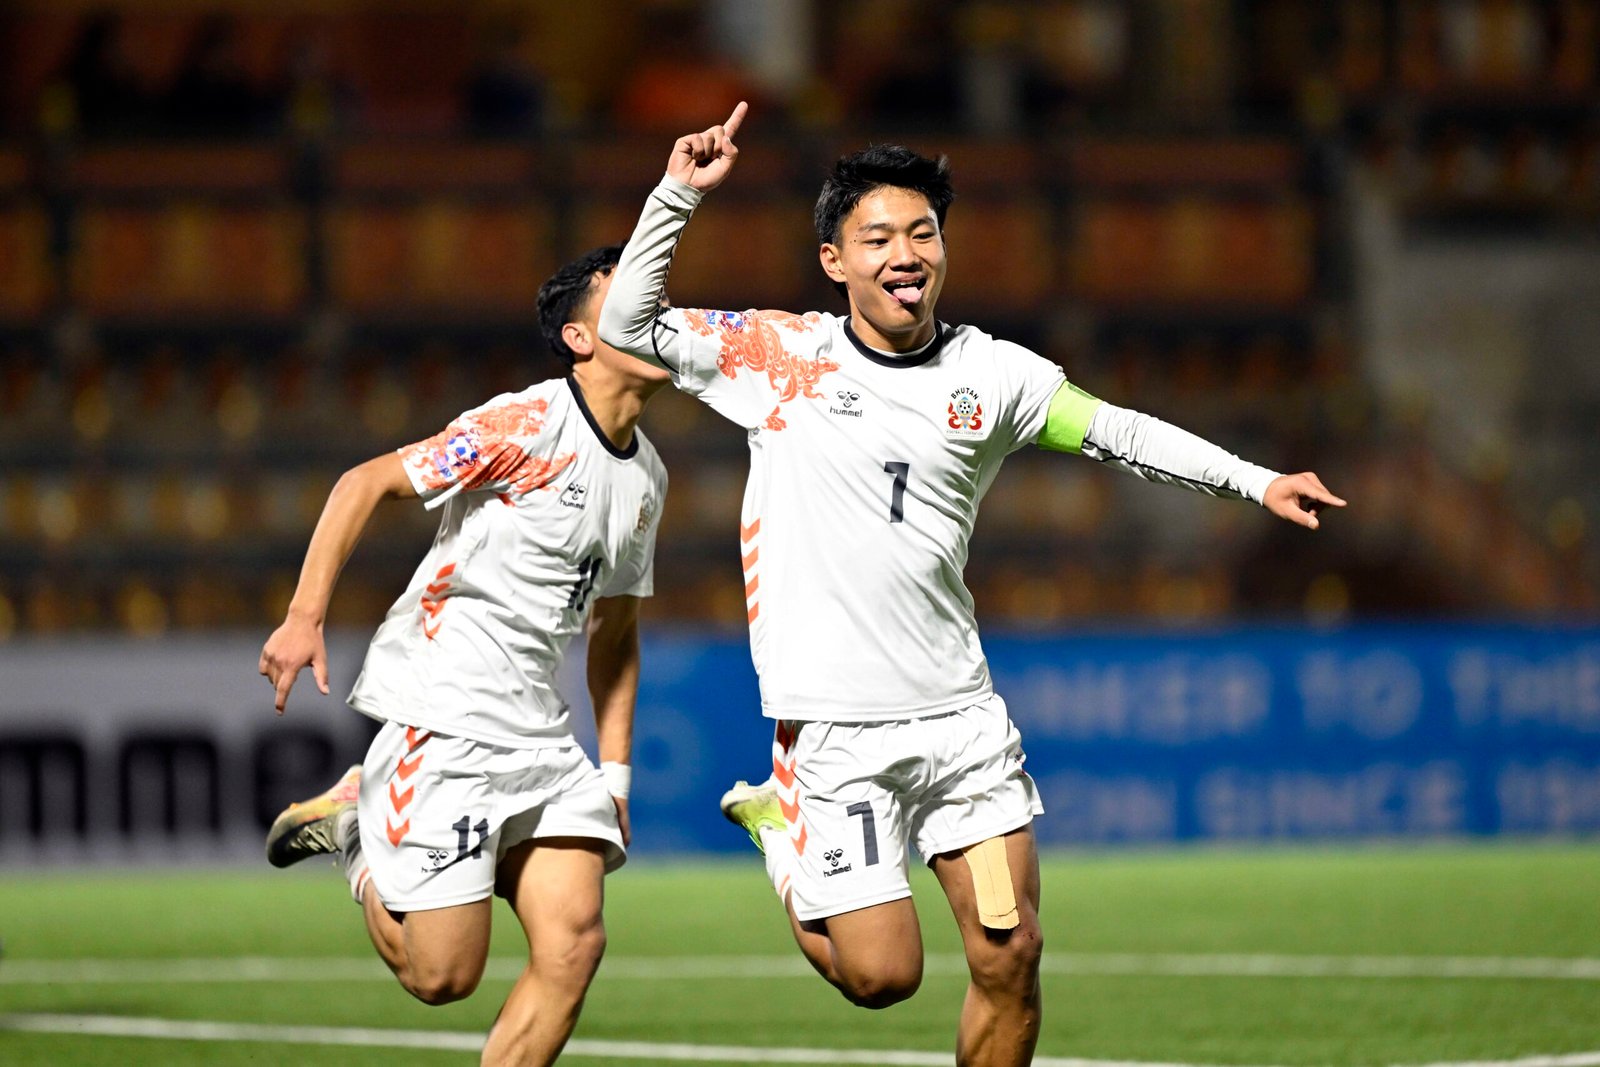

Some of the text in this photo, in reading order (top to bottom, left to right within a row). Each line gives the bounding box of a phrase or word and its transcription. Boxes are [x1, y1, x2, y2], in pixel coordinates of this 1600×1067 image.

[829, 405, 863, 418] hummel
[950, 387, 979, 400] BHUTAN
[884, 461, 910, 523] 7
[567, 555, 603, 613] 11
[452, 815, 490, 860] 11
[846, 800, 880, 867] 7
[823, 863, 852, 878] hummel
